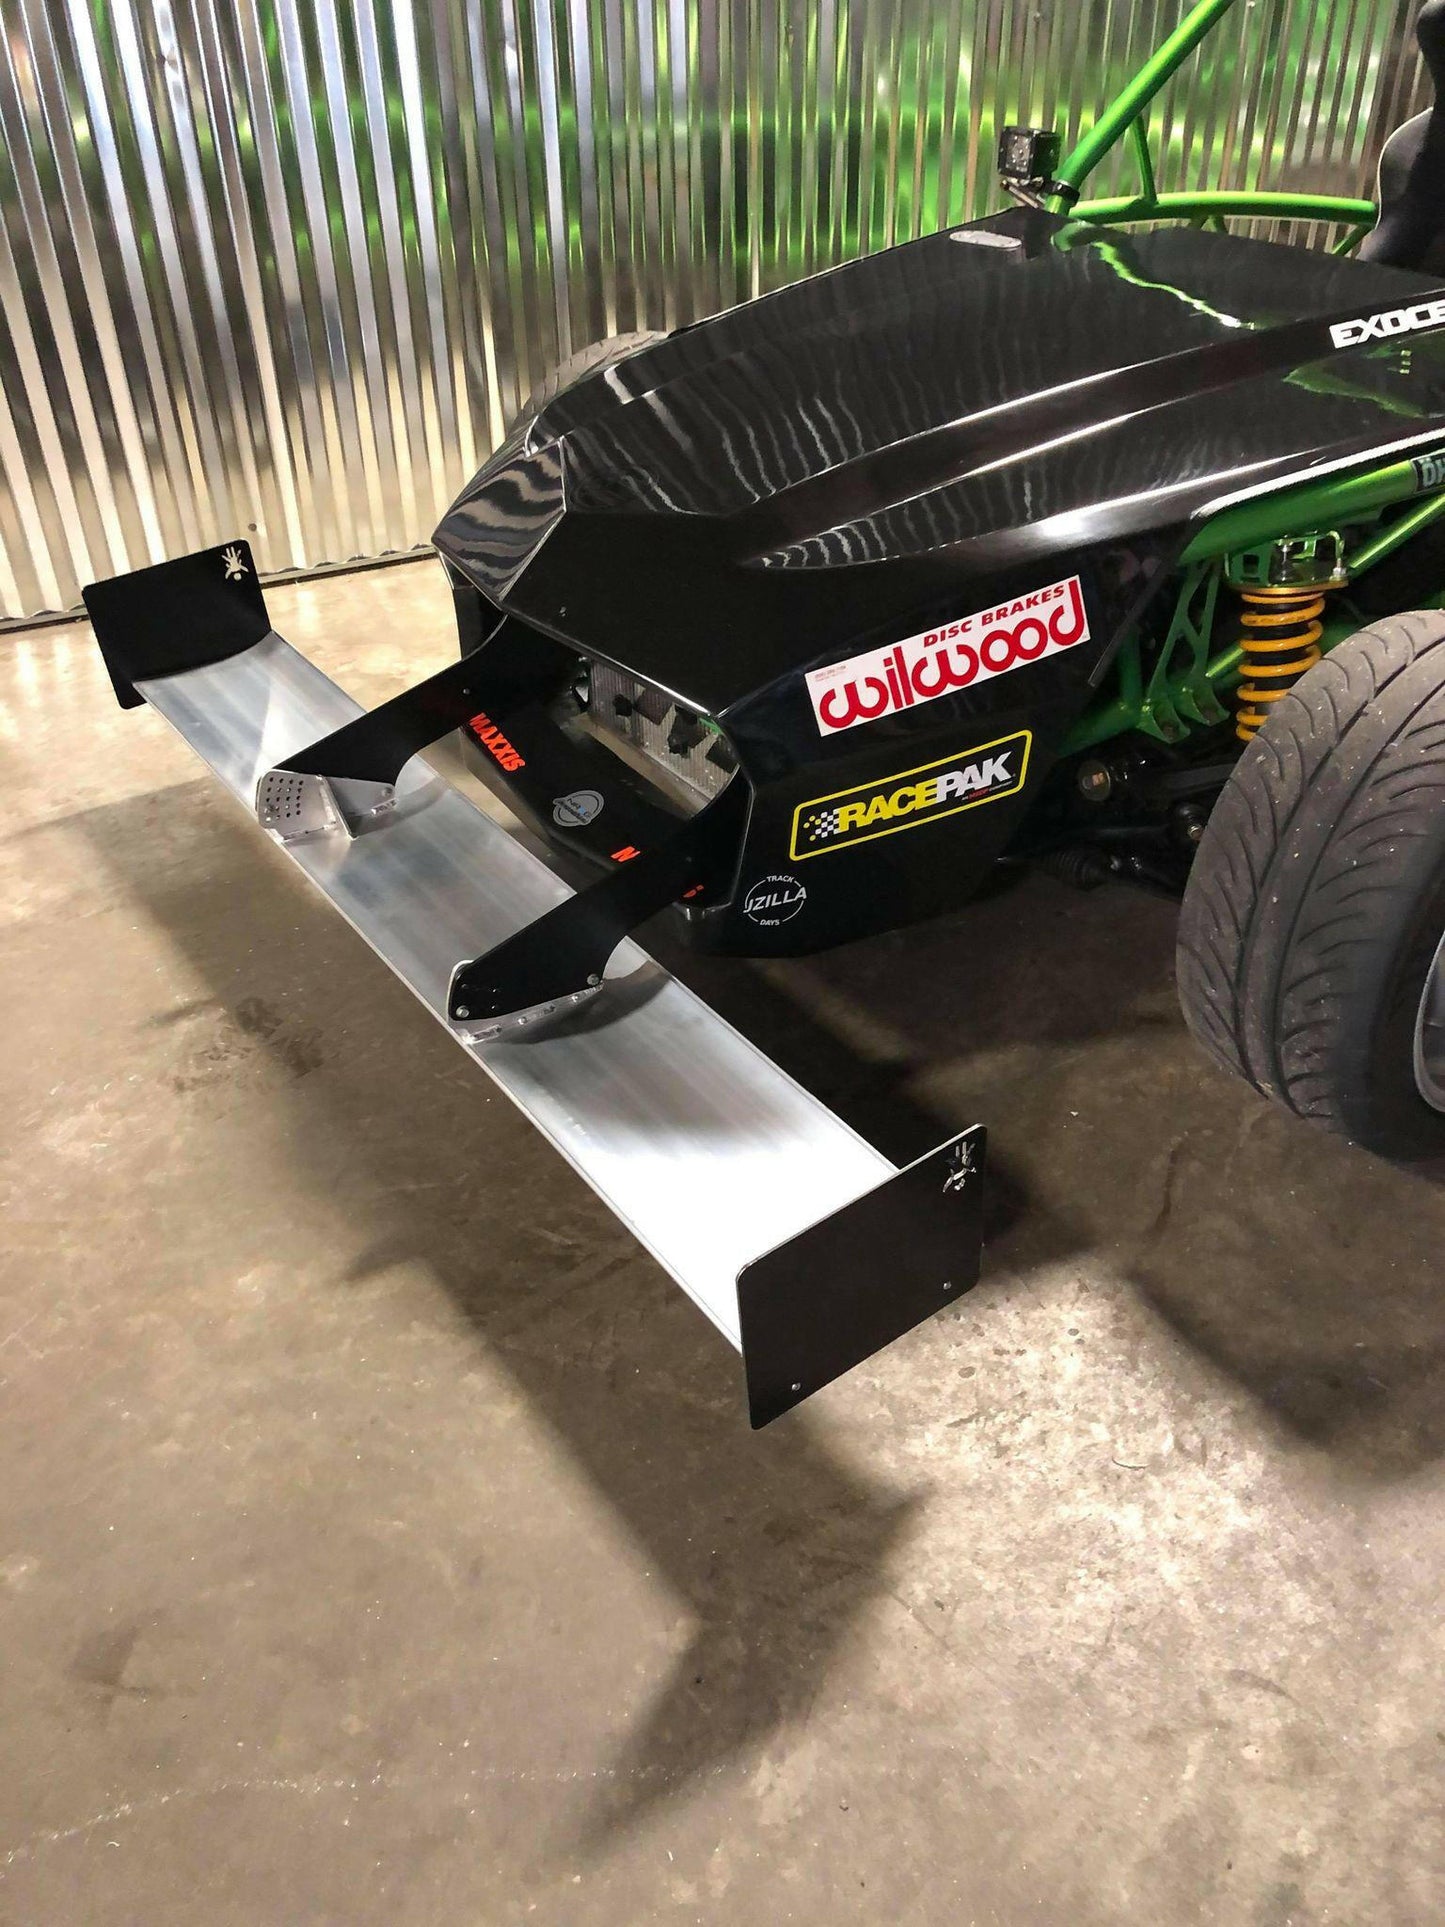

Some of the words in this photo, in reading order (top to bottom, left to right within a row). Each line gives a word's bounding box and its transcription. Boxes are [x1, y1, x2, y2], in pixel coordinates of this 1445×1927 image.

[923, 619, 973, 648] DISC
[981, 584, 1065, 627] BRAKES
[819, 579, 1085, 729] wilwood
[469, 712, 526, 771] MAXXIS
[837, 751, 1012, 833] RACEPAK
[743, 886, 807, 914] JZILLA
[766, 875, 795, 883] TRACK
